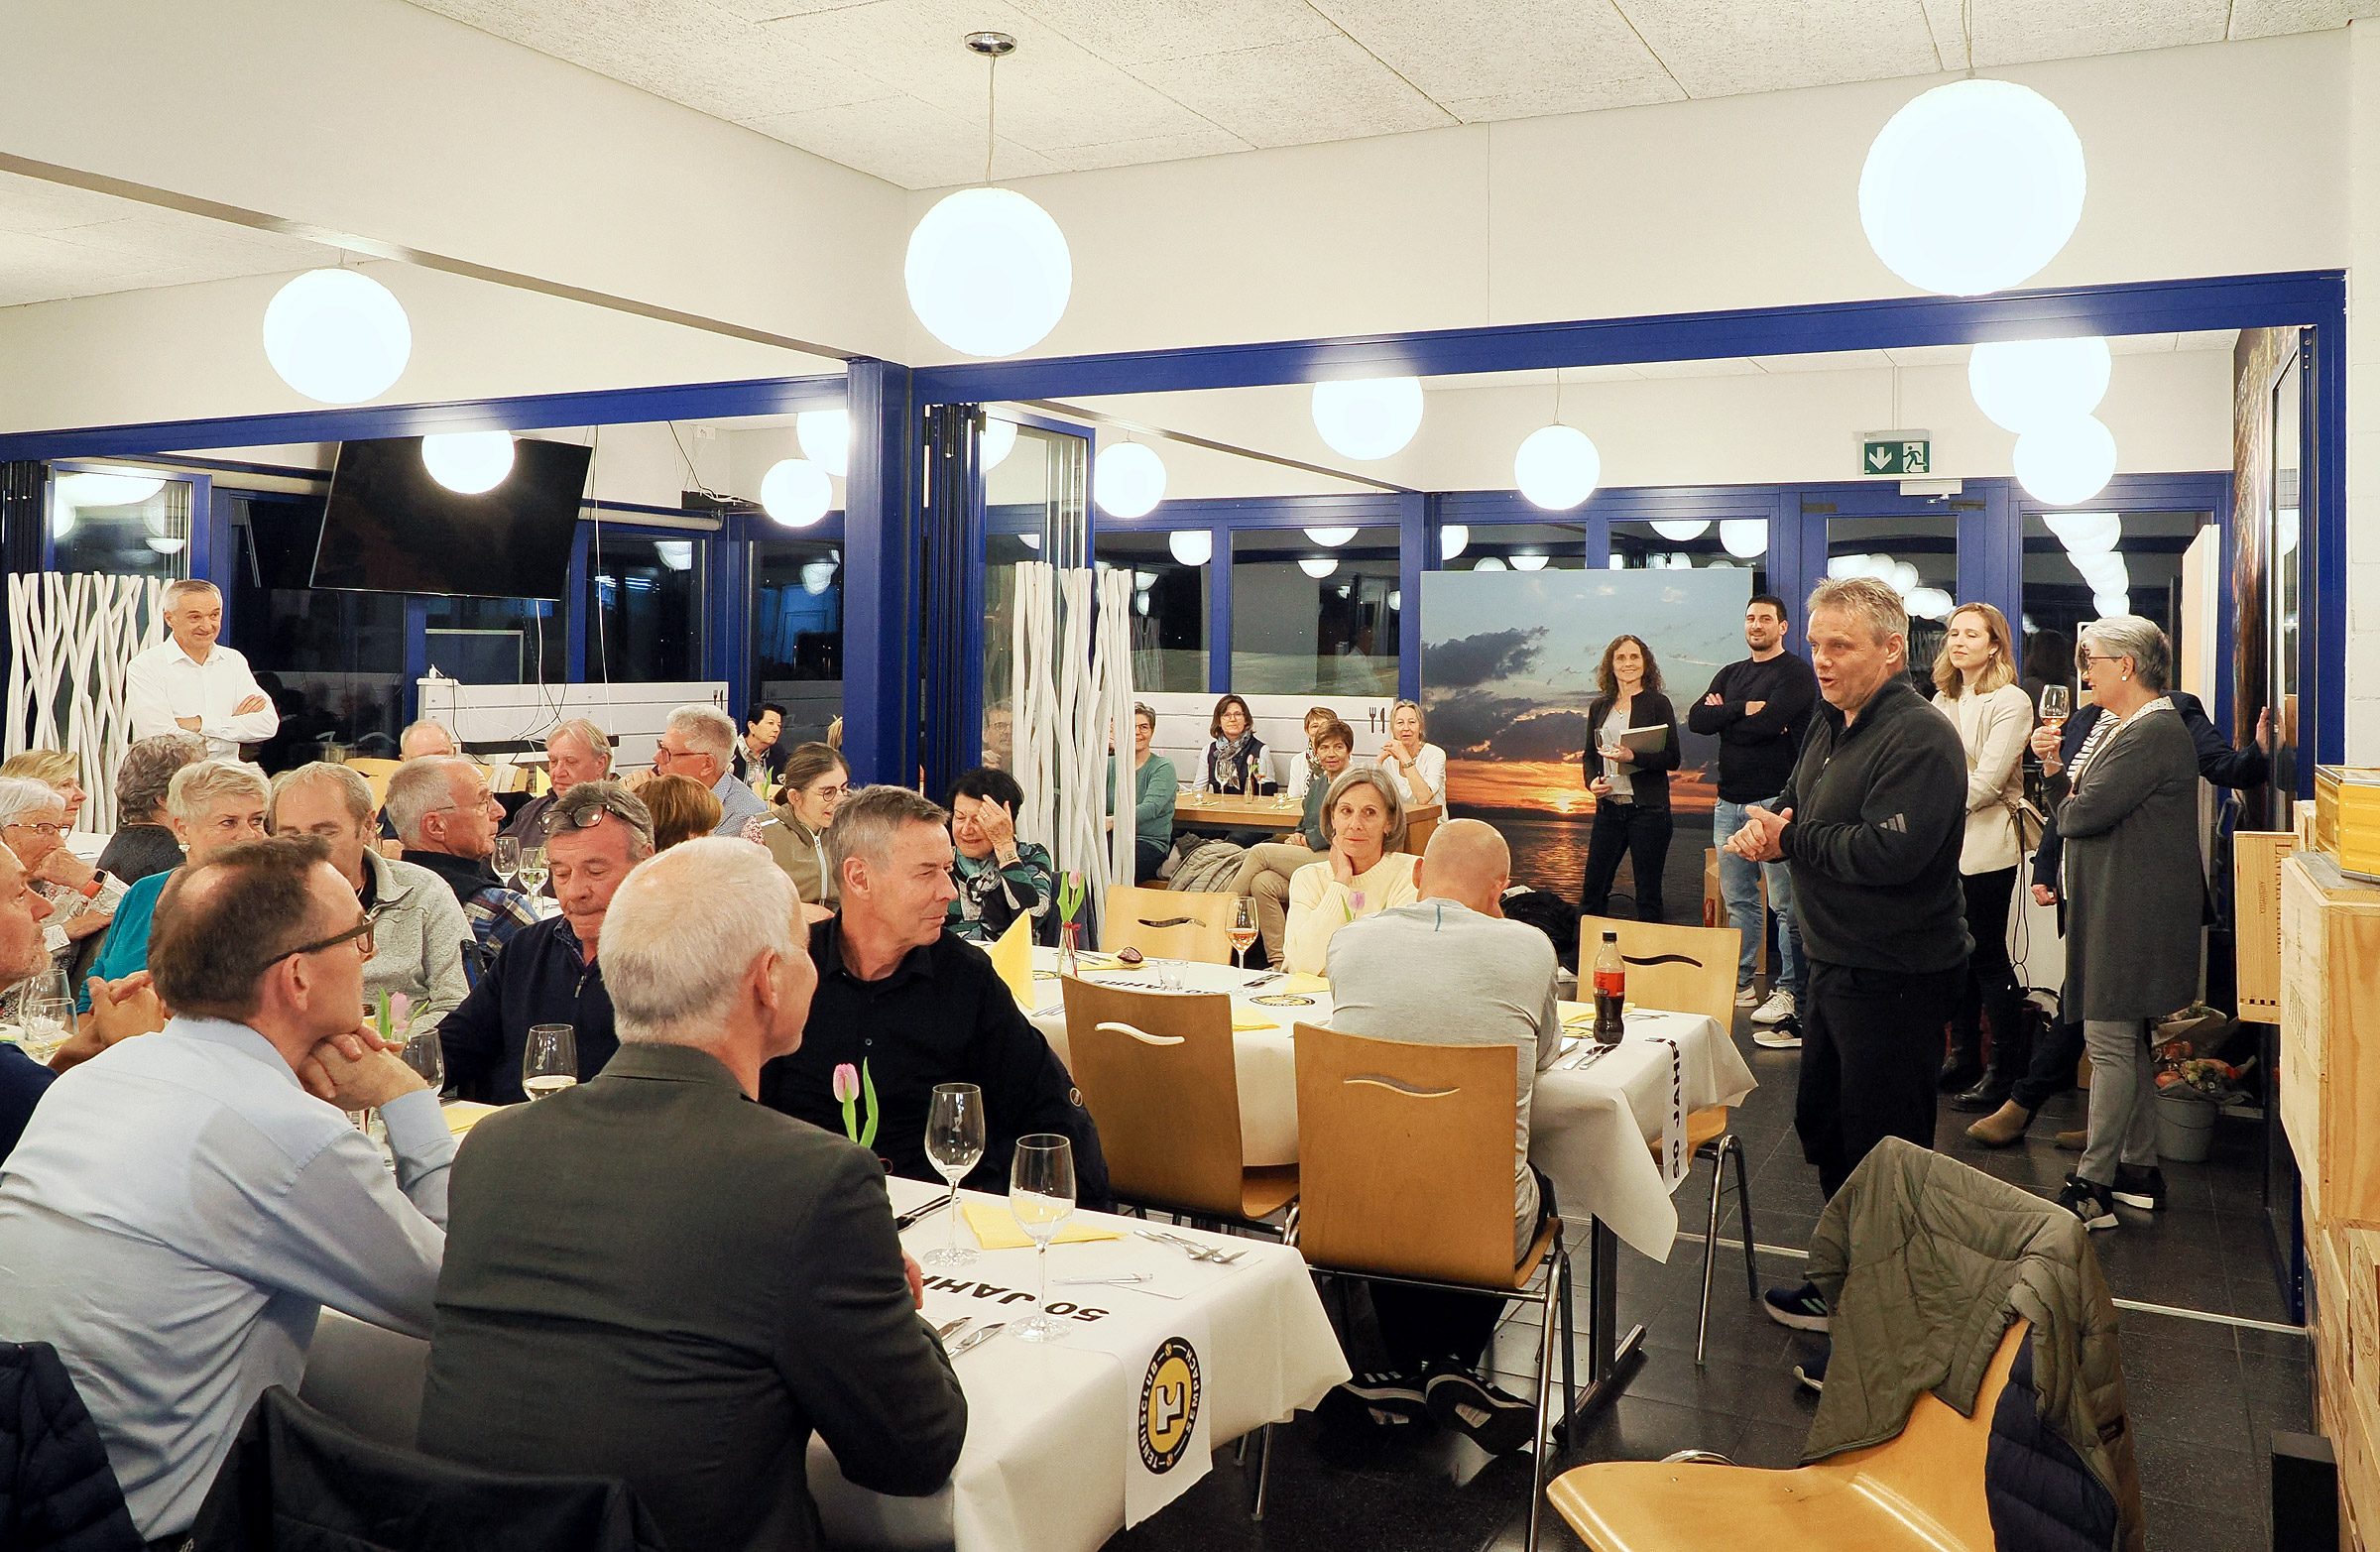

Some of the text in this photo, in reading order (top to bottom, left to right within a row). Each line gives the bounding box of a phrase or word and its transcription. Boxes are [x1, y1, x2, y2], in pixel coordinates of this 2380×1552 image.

[1673, 1139, 1680, 1179] 50
[1044, 1302, 1110, 1322] 50
[1139, 1361, 1159, 1469] TENNISCLUB
[1185, 1349, 1200, 1434] SEMPACH
